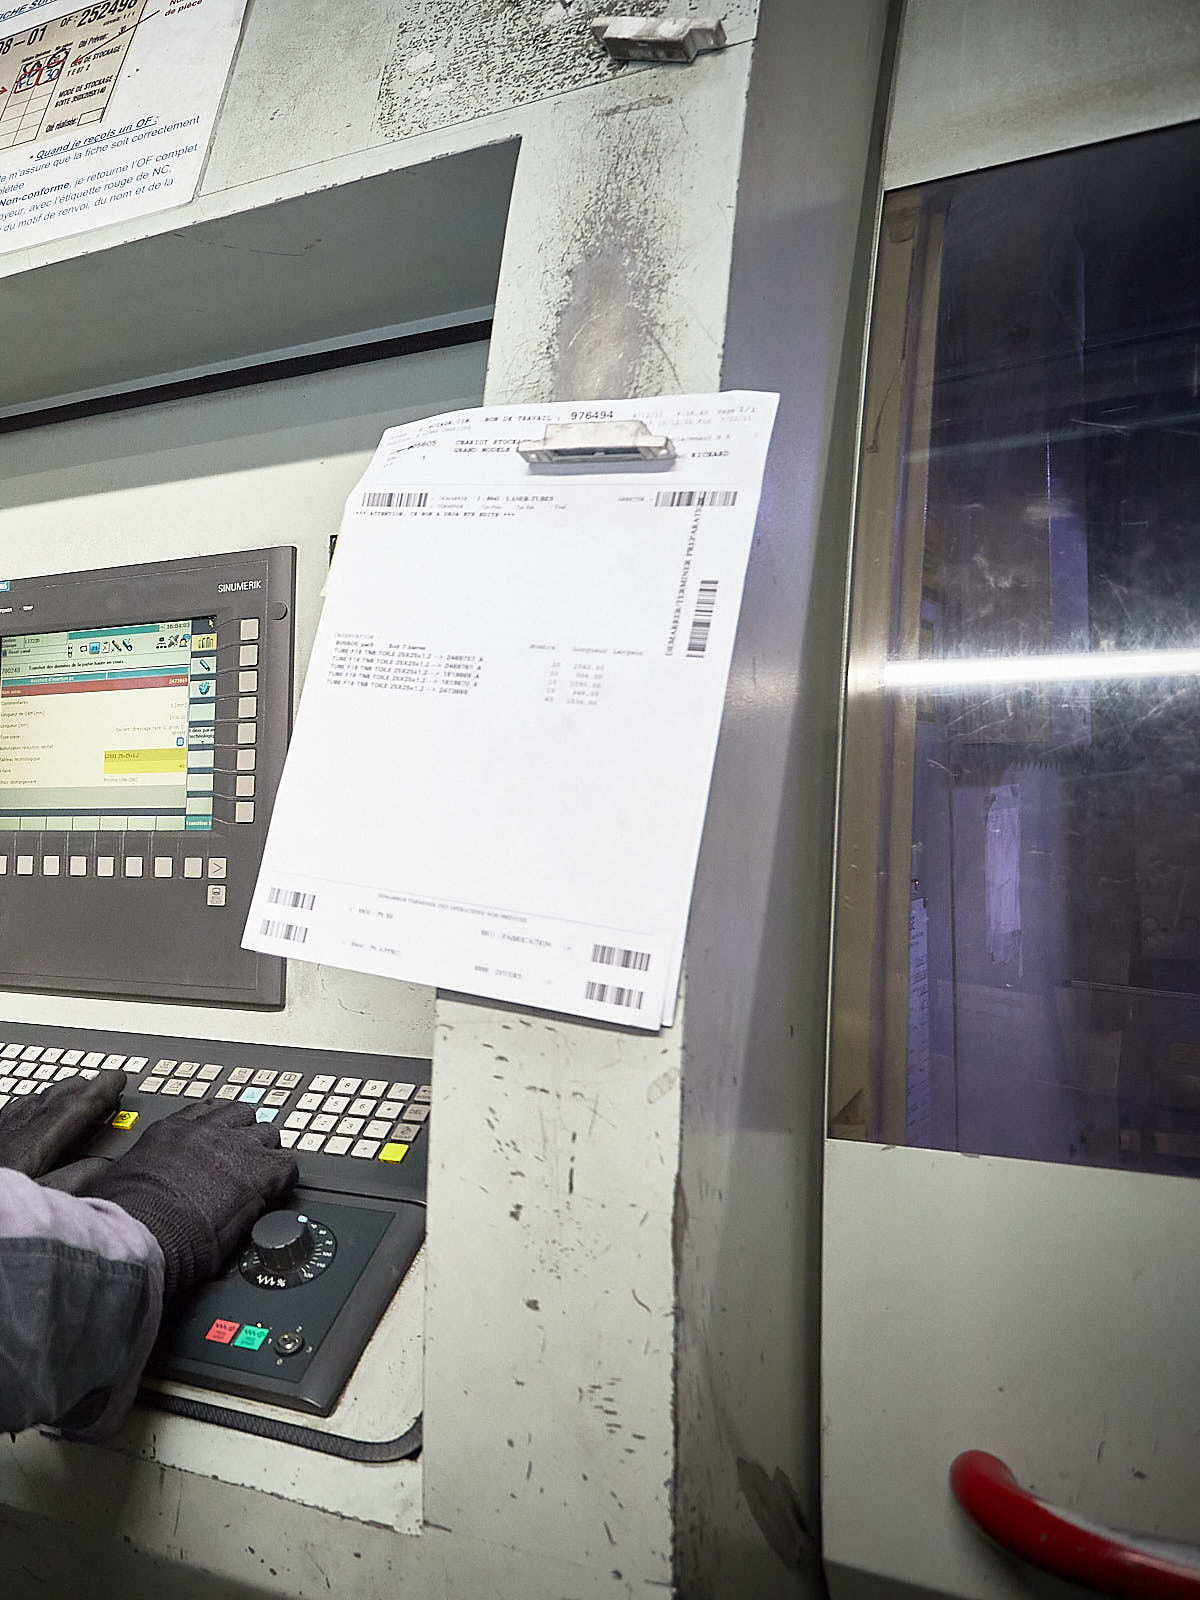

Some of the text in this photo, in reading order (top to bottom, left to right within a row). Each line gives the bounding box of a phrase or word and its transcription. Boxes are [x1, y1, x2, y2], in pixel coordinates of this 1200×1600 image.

[59, 89, 76, 98] MODE
[84, 74, 113, 90] STOCKAGE
[8, 160, 51, 179] m'assure
[53, 154, 71, 167] que
[74, 152, 82, 160] la
[85, 144, 108, 157] fiche
[111, 137, 129, 149] soit
[131, 116, 200, 142] correctement
[36, 116, 154, 160] Quand je reçois un OF
[74, 178, 84, 188] je
[86, 164, 129, 182] retourne
[131, 156, 154, 169] l'OF
[156, 144, 198, 161] complet
[4, 220, 15, 231] du
[17, 214, 42, 227] motif
[43, 211, 55, 220] de
[94, 196, 107, 207] du
[109, 191, 132, 202] nom
[135, 186, 145, 195] et
[148, 182, 161, 192] de
[164, 178, 174, 187] la
[28, 198, 53, 212] avec
[54, 185, 101, 205] l'étiquette
[103, 176, 133, 191] rouge
[135, 172, 149, 181] de
[571, 411, 614, 420] 976494
[217, 581, 262, 593] SINUMERIK
